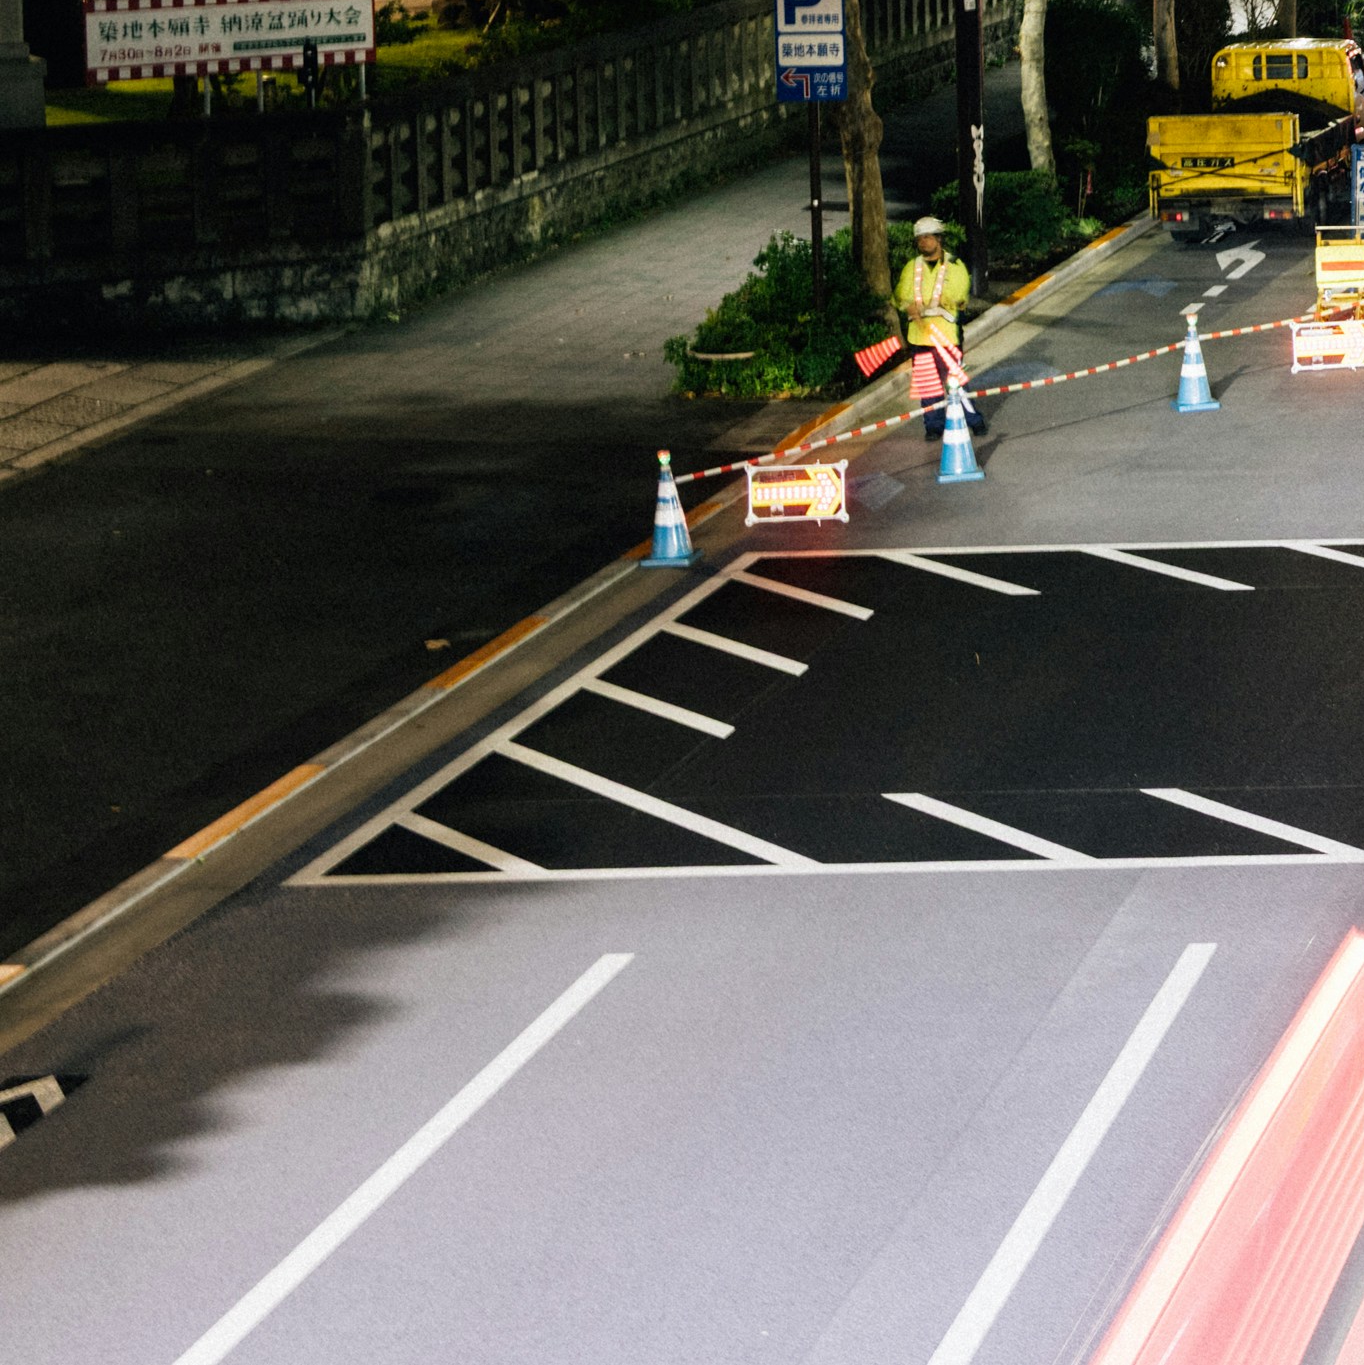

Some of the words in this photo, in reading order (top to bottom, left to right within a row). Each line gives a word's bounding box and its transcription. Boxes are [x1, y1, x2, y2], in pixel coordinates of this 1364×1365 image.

[99, 15, 211, 43] 築地本願寺
[220, 5, 362, 35] 納涼盆踊り大会
[782, 43, 840, 57] 築地本願寺
[813, 72, 844, 84] 次の信号
[816, 84, 841, 96] 左折
[1183, 158, 1232, 167] 高圧ガス
